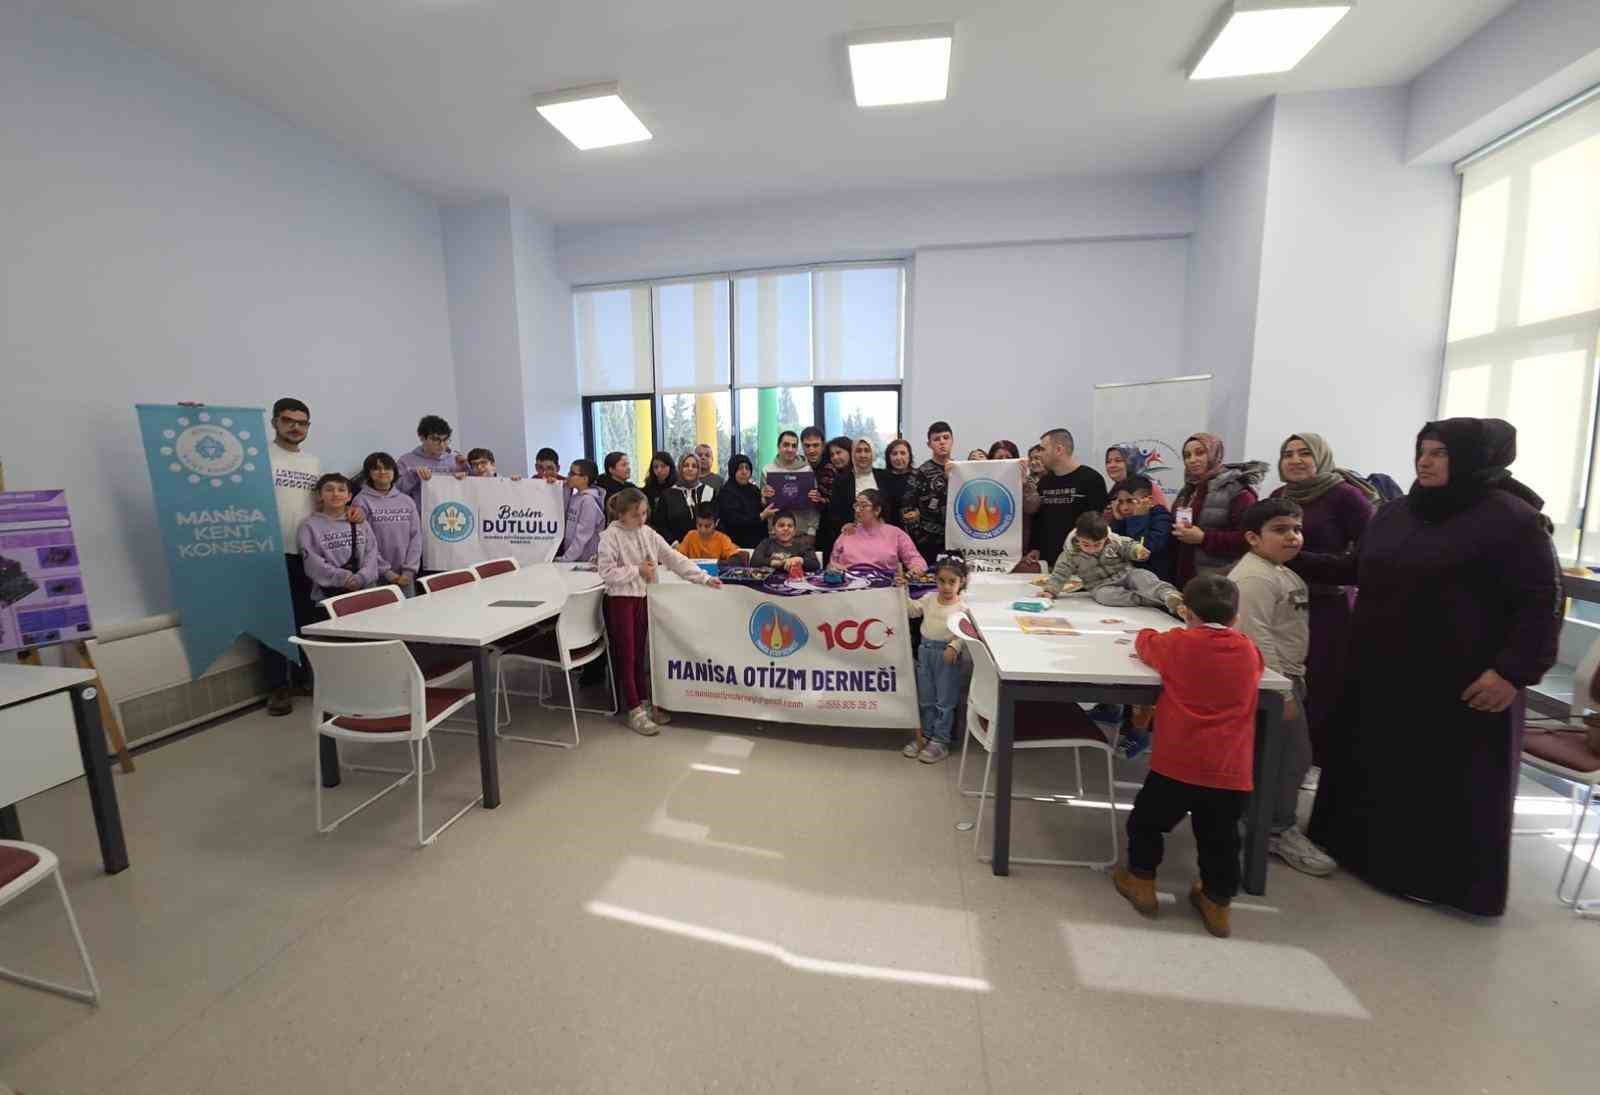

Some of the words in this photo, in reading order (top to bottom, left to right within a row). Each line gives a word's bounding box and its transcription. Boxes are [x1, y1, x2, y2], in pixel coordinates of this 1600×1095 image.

[175, 505, 266, 525] MANİSA
[498, 504, 543, 519] Besim
[193, 525, 254, 541] KENT
[482, 519, 558, 534] DUTLULU
[176, 535, 275, 558] KONSEYİ
[667, 658, 738, 686] MANİSA
[743, 661, 807, 691] OTİZM
[812, 666, 897, 692] DERNEĞİ
